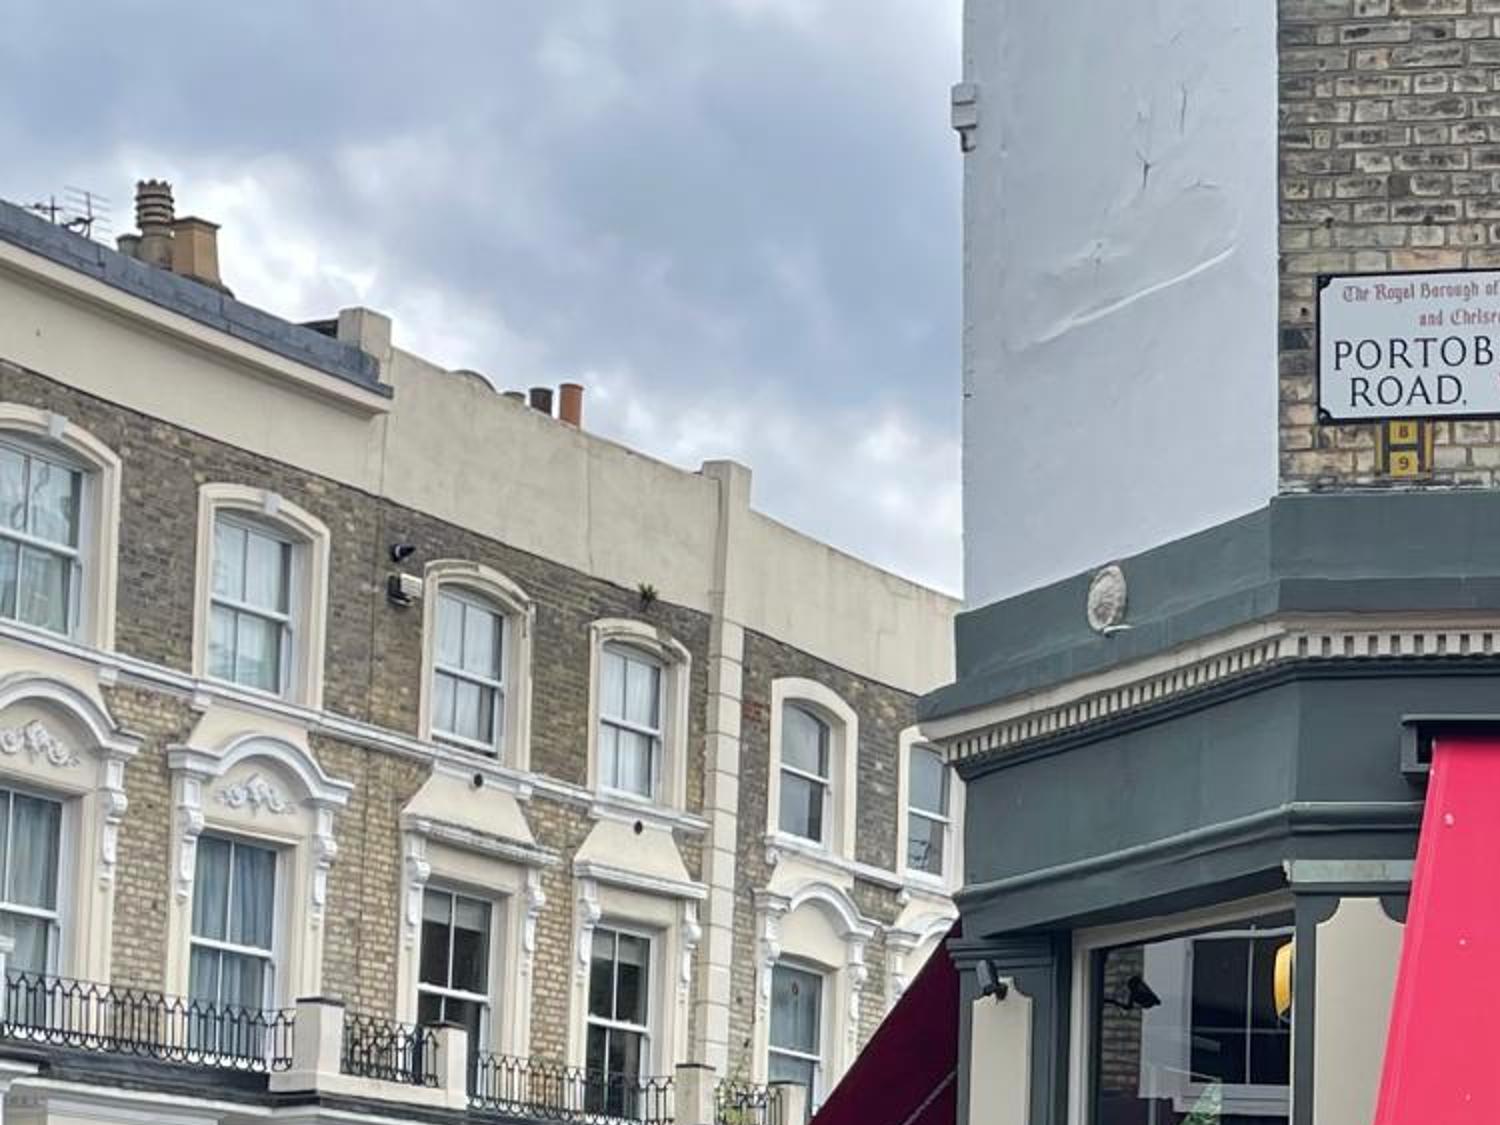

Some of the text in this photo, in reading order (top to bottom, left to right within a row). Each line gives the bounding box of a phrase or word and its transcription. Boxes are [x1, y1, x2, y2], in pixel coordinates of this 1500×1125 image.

[1342, 285, 1369, 303] The
[1374, 283, 1416, 304] Royal
[1420, 281, 1479, 303] Borough
[1485, 279, 1500, 297] of
[1419, 309, 1444, 327] and
